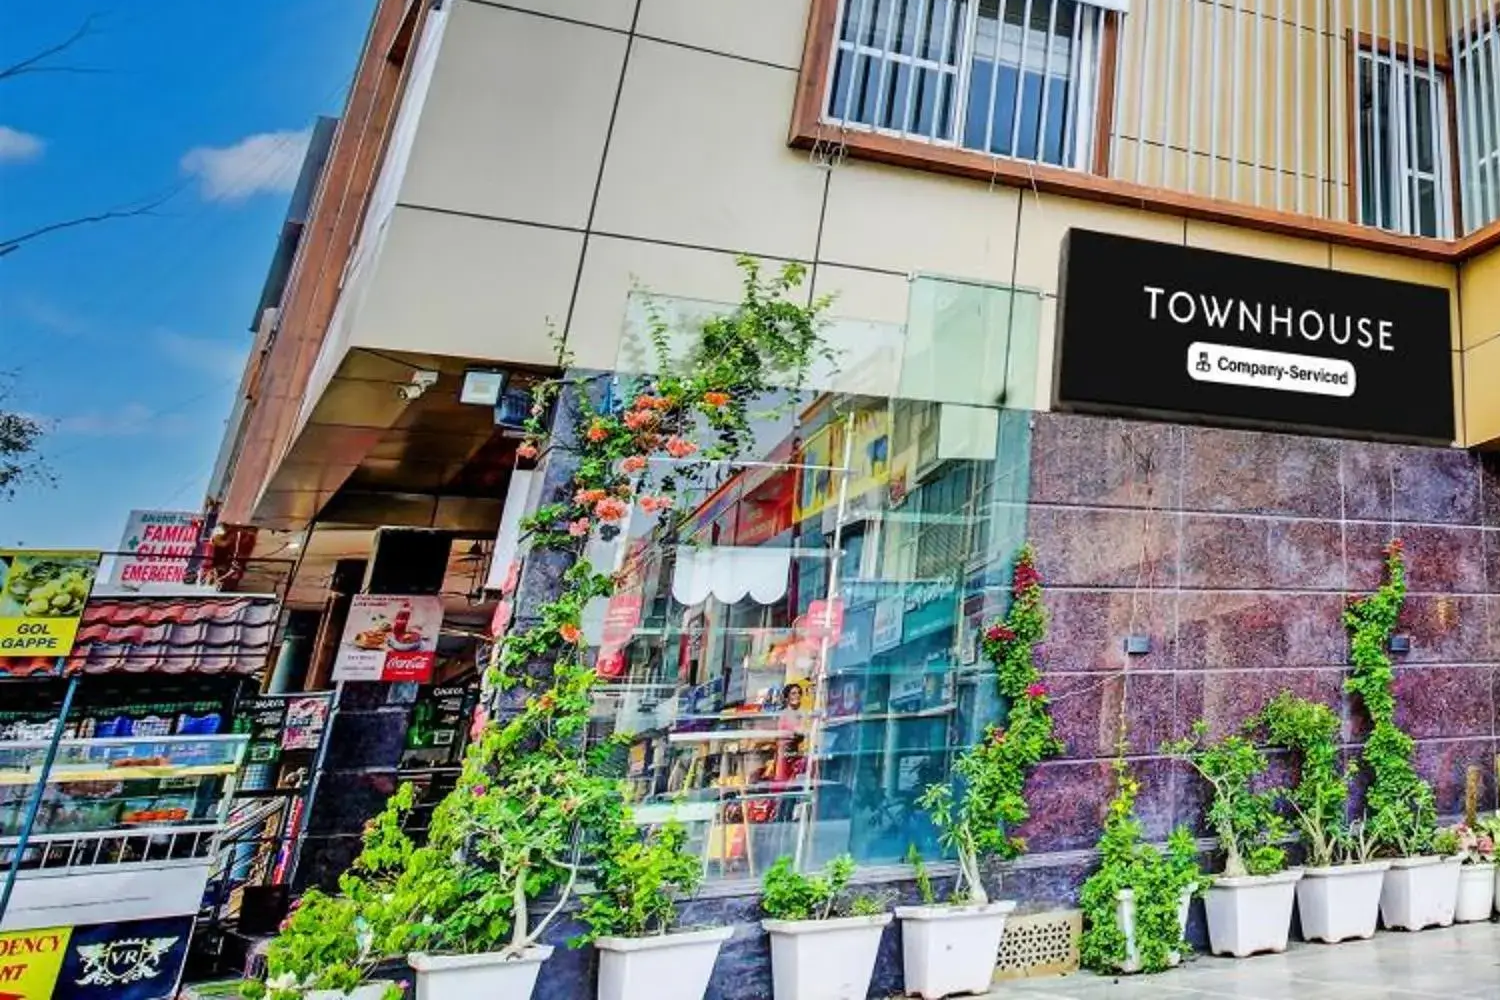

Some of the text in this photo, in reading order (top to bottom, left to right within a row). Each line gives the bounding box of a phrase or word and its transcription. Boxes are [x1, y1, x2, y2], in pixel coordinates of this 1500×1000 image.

[1143, 285, 1395, 352] TOWNHOUSE
[1217, 354, 1349, 387] Company-Serviced
[17, 623, 51, 635] GOL
[1, 637, 59, 649] GAPPE
[112, 949, 138, 966] VR
